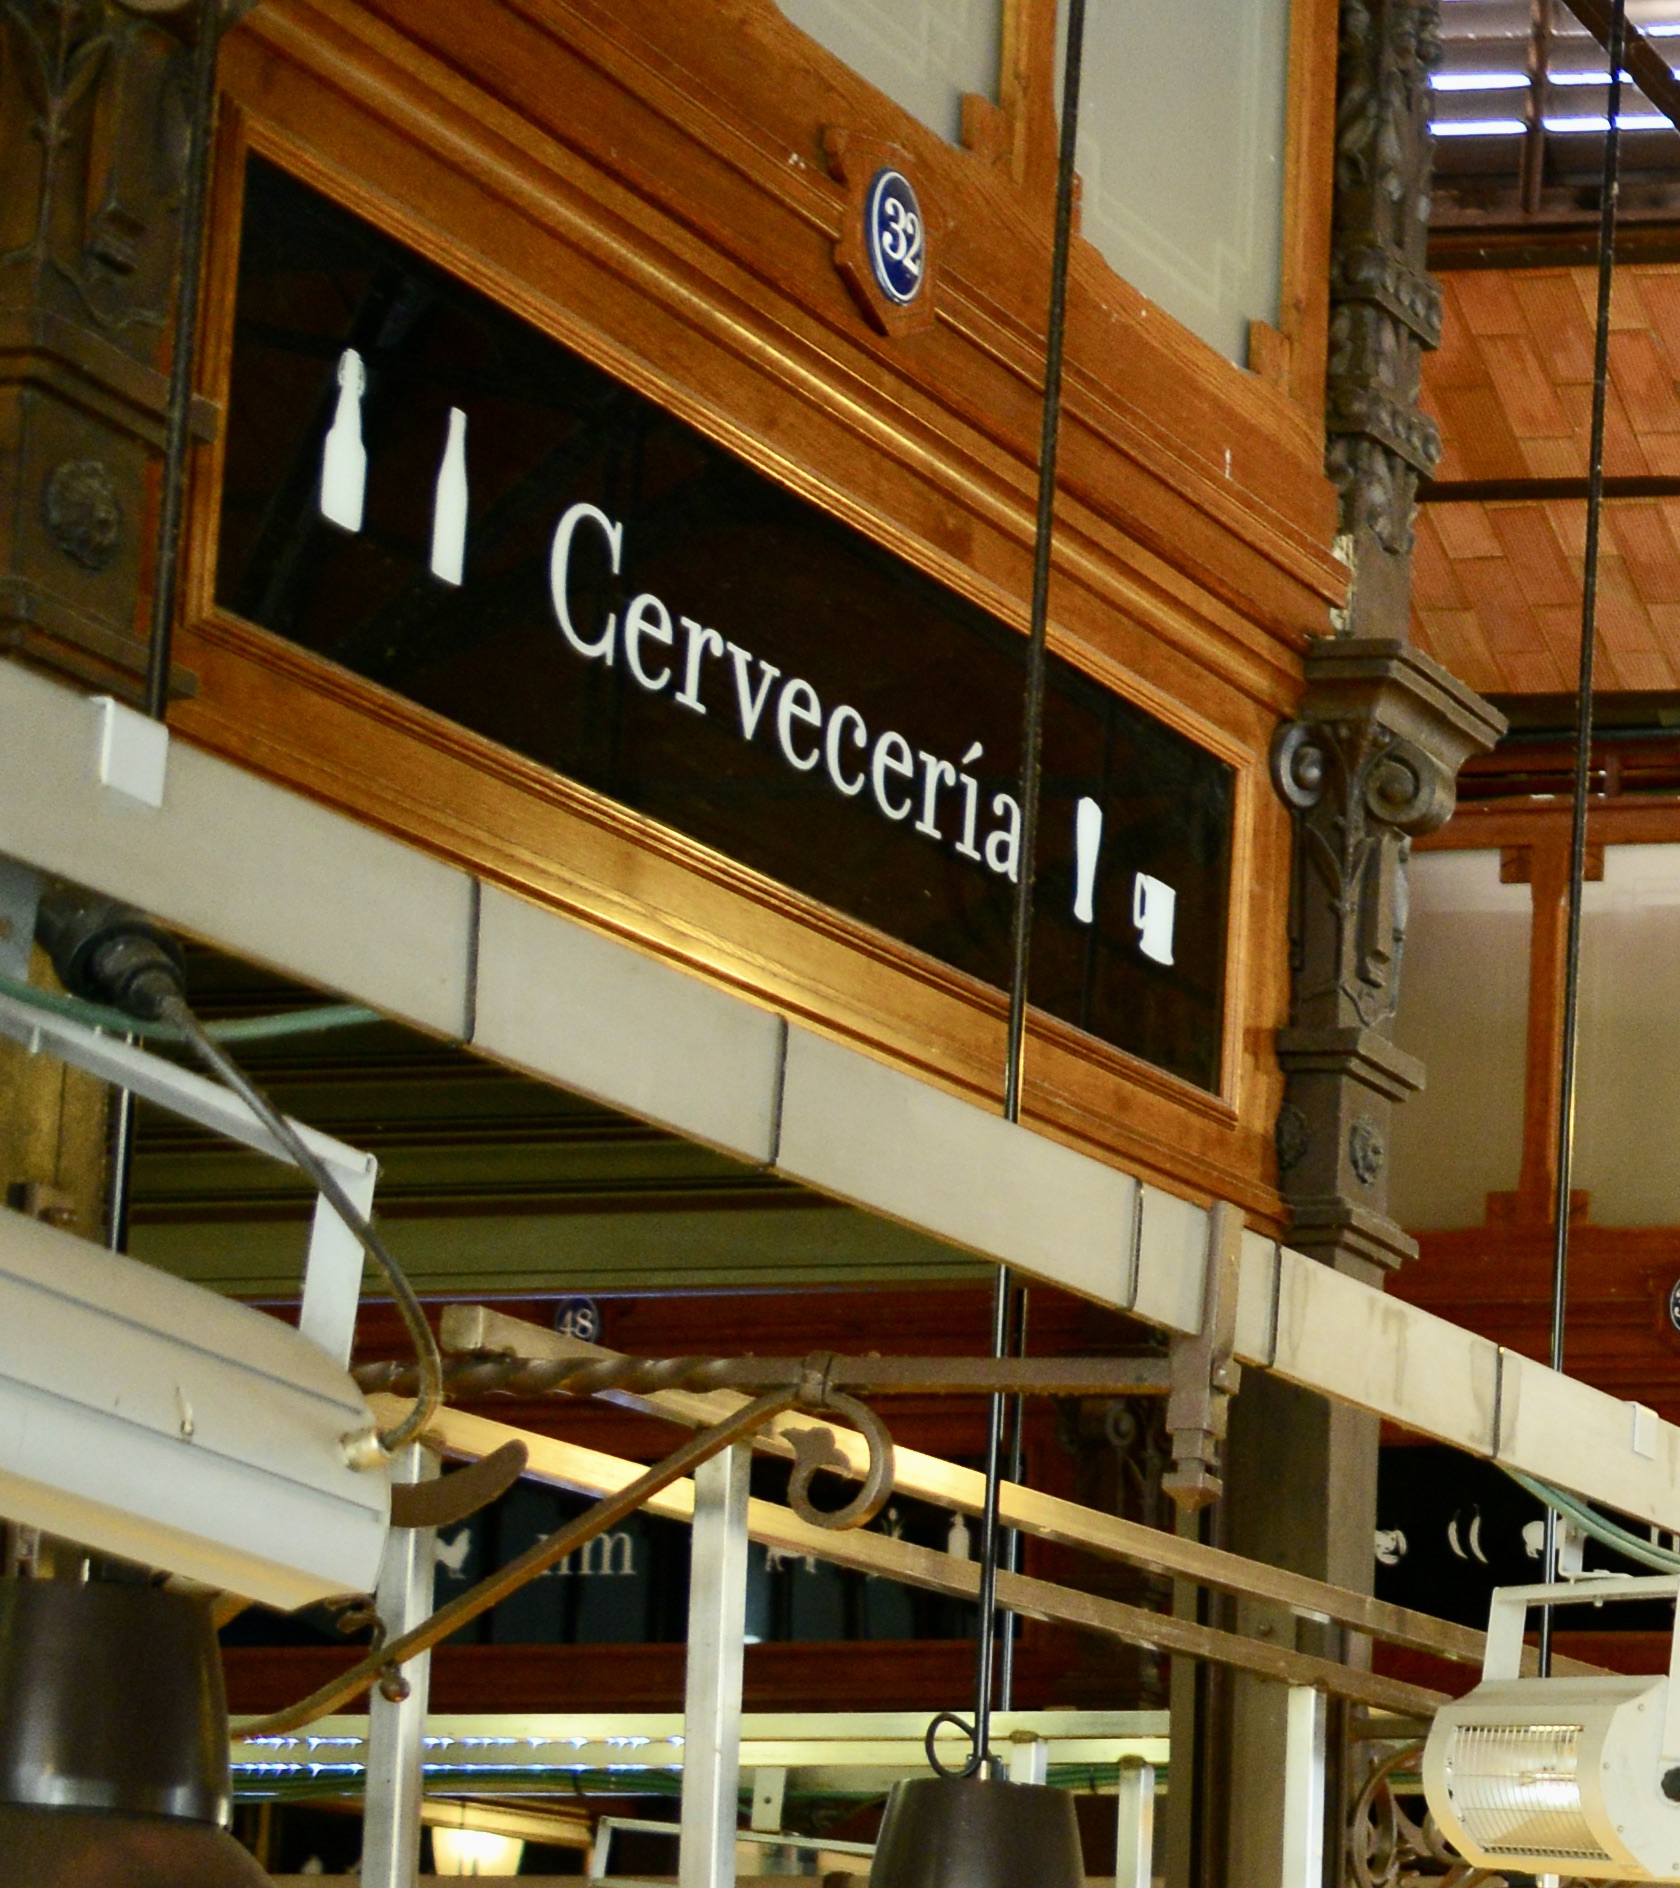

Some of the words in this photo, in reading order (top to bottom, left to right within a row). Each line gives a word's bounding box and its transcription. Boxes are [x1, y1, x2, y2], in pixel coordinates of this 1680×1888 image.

[882, 197, 920, 277] 32
[548, 503, 1025, 884] Cervecería
[558, 1307, 594, 1340] 48
